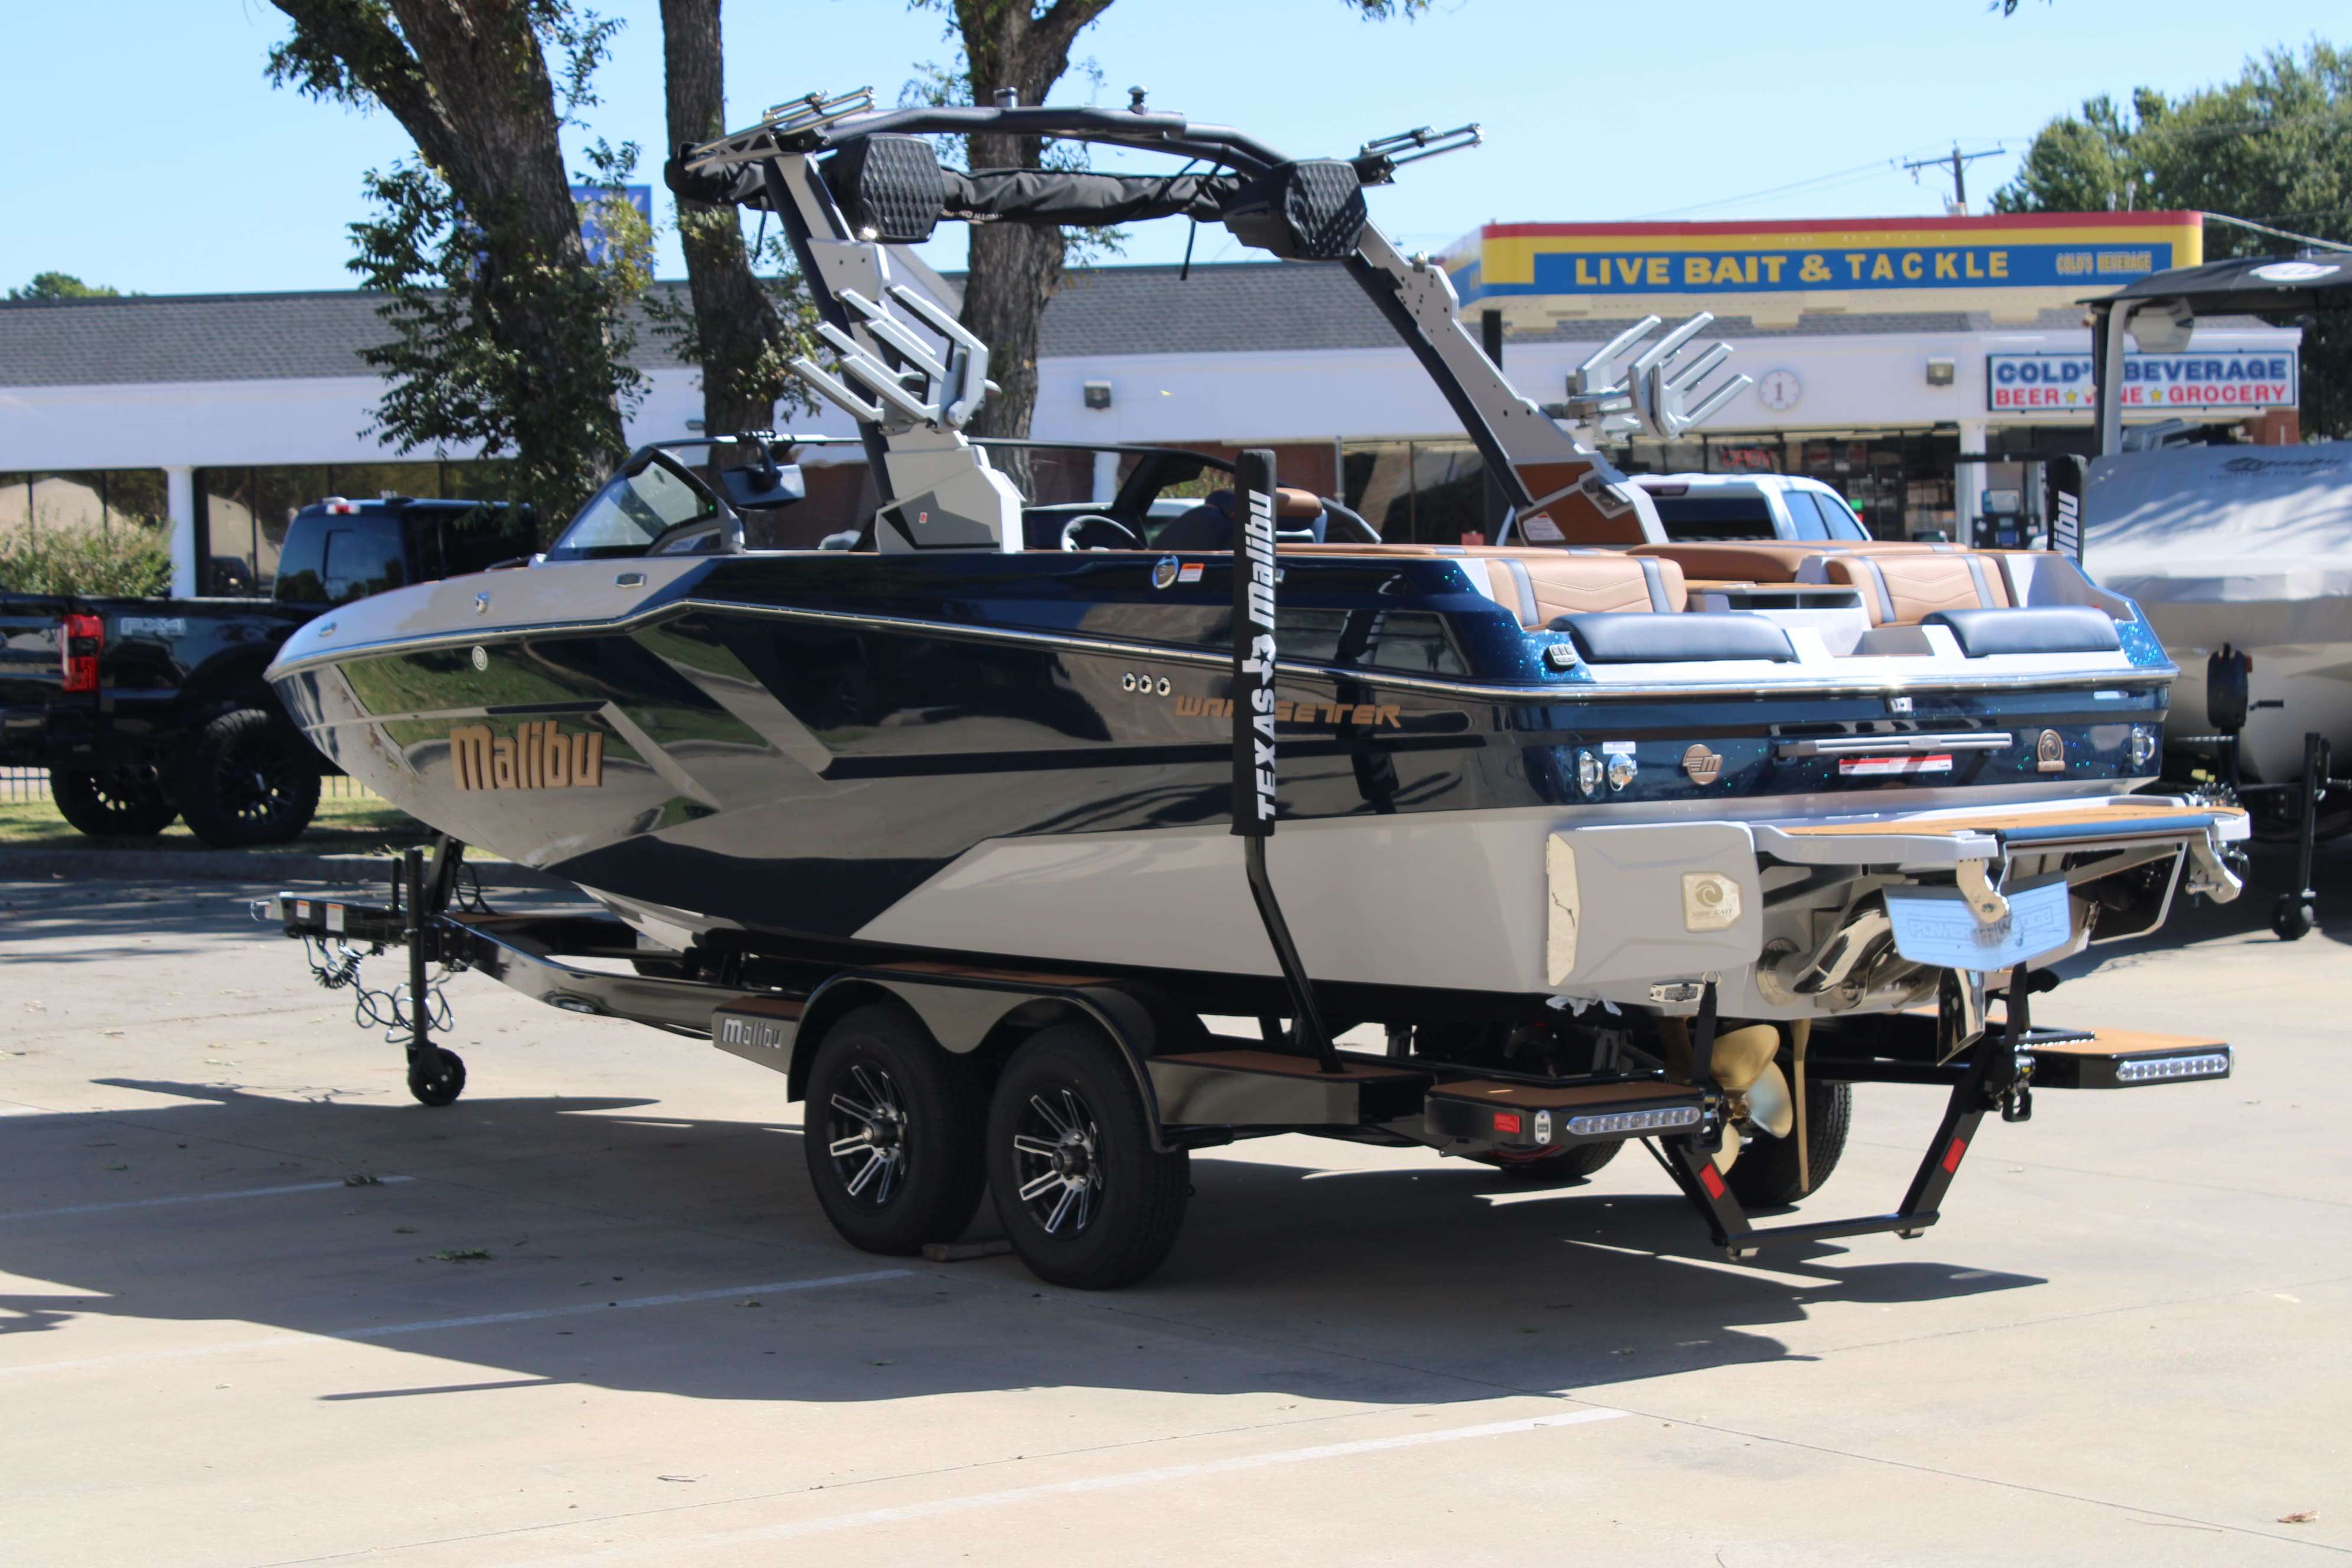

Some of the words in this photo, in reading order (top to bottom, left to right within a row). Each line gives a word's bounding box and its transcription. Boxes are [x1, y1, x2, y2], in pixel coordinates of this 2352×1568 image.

[1575, 257, 1670, 285] LIVE
[1684, 256, 1786, 284] BAIT
[1799, 254, 1832, 282] &
[1845, 251, 2008, 280] TACKLE
[2056, 253, 2093, 275] COLD'S
[2096, 251, 2152, 273] BEVERAGE
[1996, 361, 2091, 383] COLD'
[2124, 358, 2286, 381] BEVERAGE
[1995, 388, 2059, 405] BEER
[2169, 384, 2286, 403] GROCERY
[1723, 449, 1773, 468] OPEN
[2053, 490, 2078, 559] libu
[120, 618, 185, 636] FX4
[1252, 688, 1275, 821] TEXAS
[1909, 920, 1971, 940] POWER
